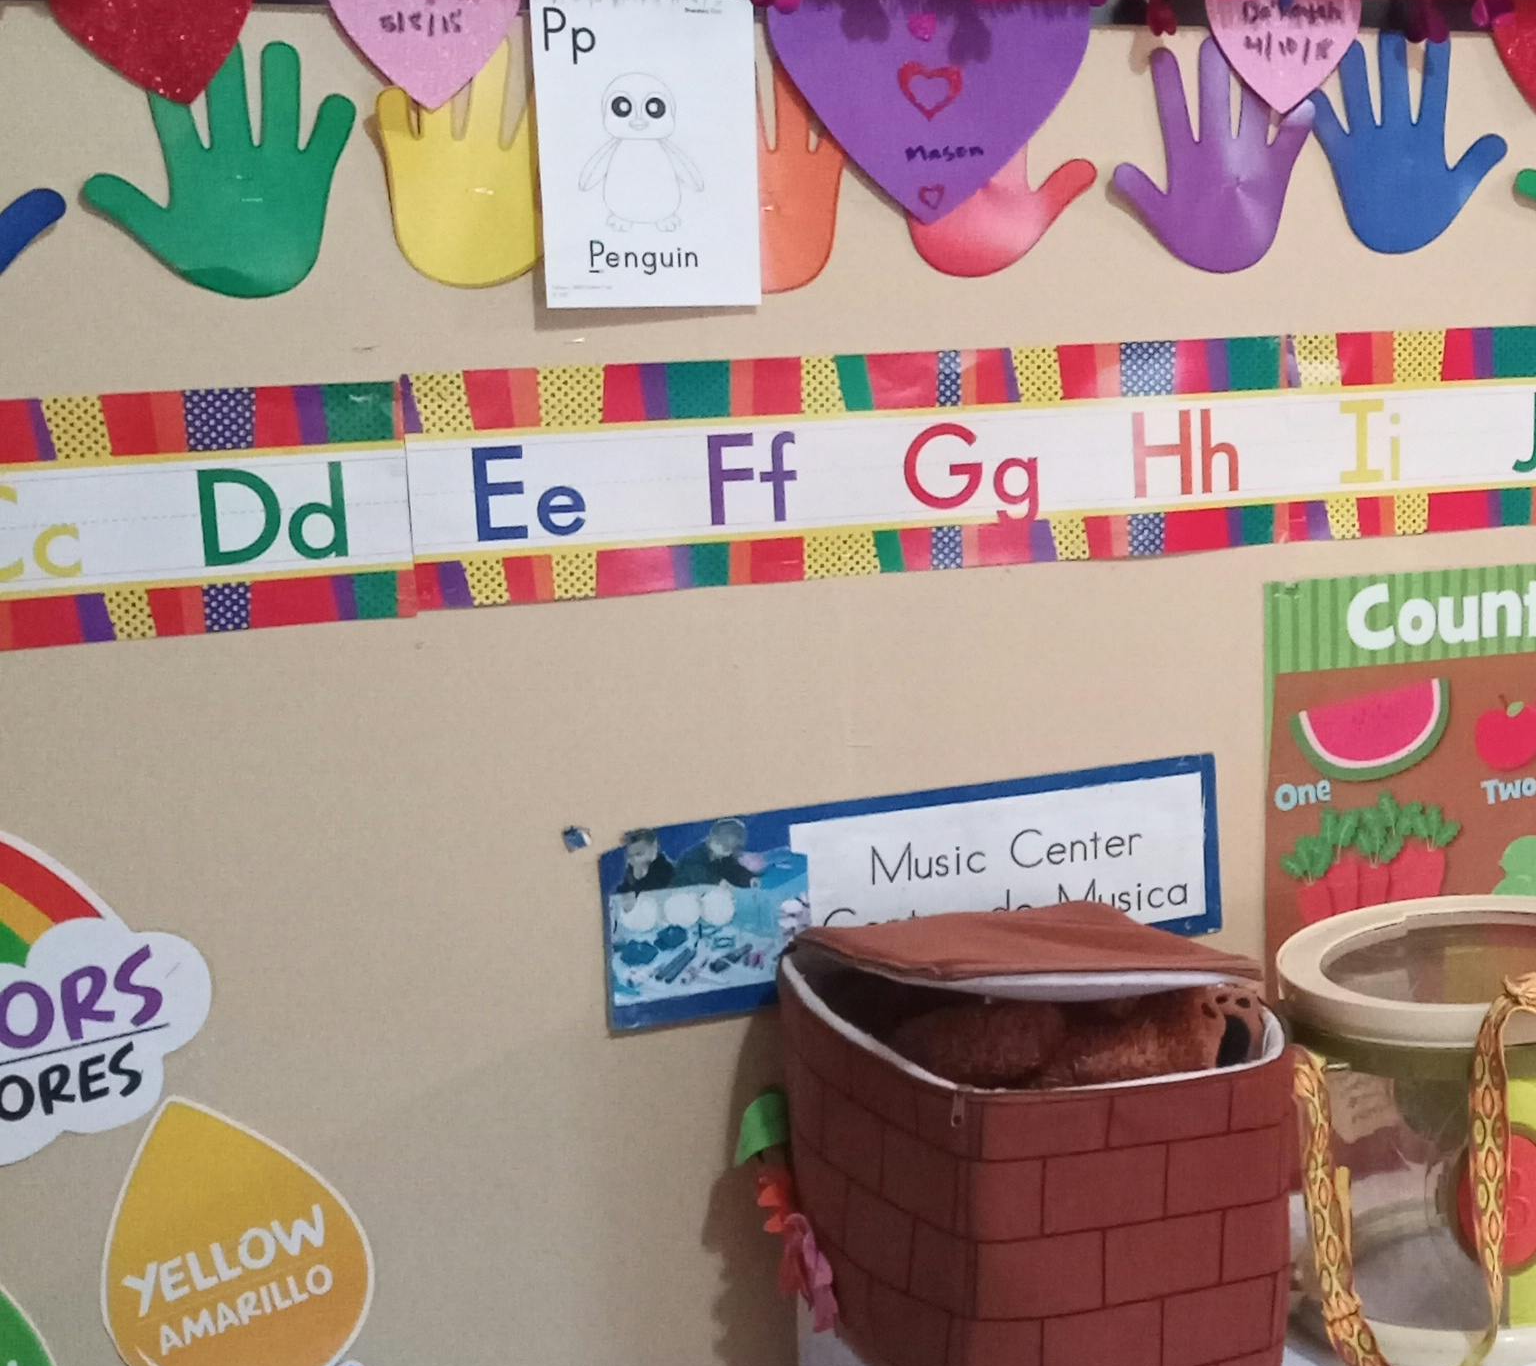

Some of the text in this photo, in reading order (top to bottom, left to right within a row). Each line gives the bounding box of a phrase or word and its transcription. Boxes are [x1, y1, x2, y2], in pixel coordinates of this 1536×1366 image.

[541, 6, 596, 65] Pp
[589, 239, 700, 275] Penguin
[197, 460, 348, 568] Dd
[470, 445, 587, 542] Ee
[706, 431, 798, 526] Ff
[903, 423, 1040, 521] Gg
[1132, 409, 1240, 498] Hh
[1340, 398, 1402, 484] Ii
[1273, 778, 1333, 811] One
[869, 827, 1144, 885] Music Center
[122, 1204, 329, 1319] YELLOW
[157, 1262, 336, 1358] AMARILLO
